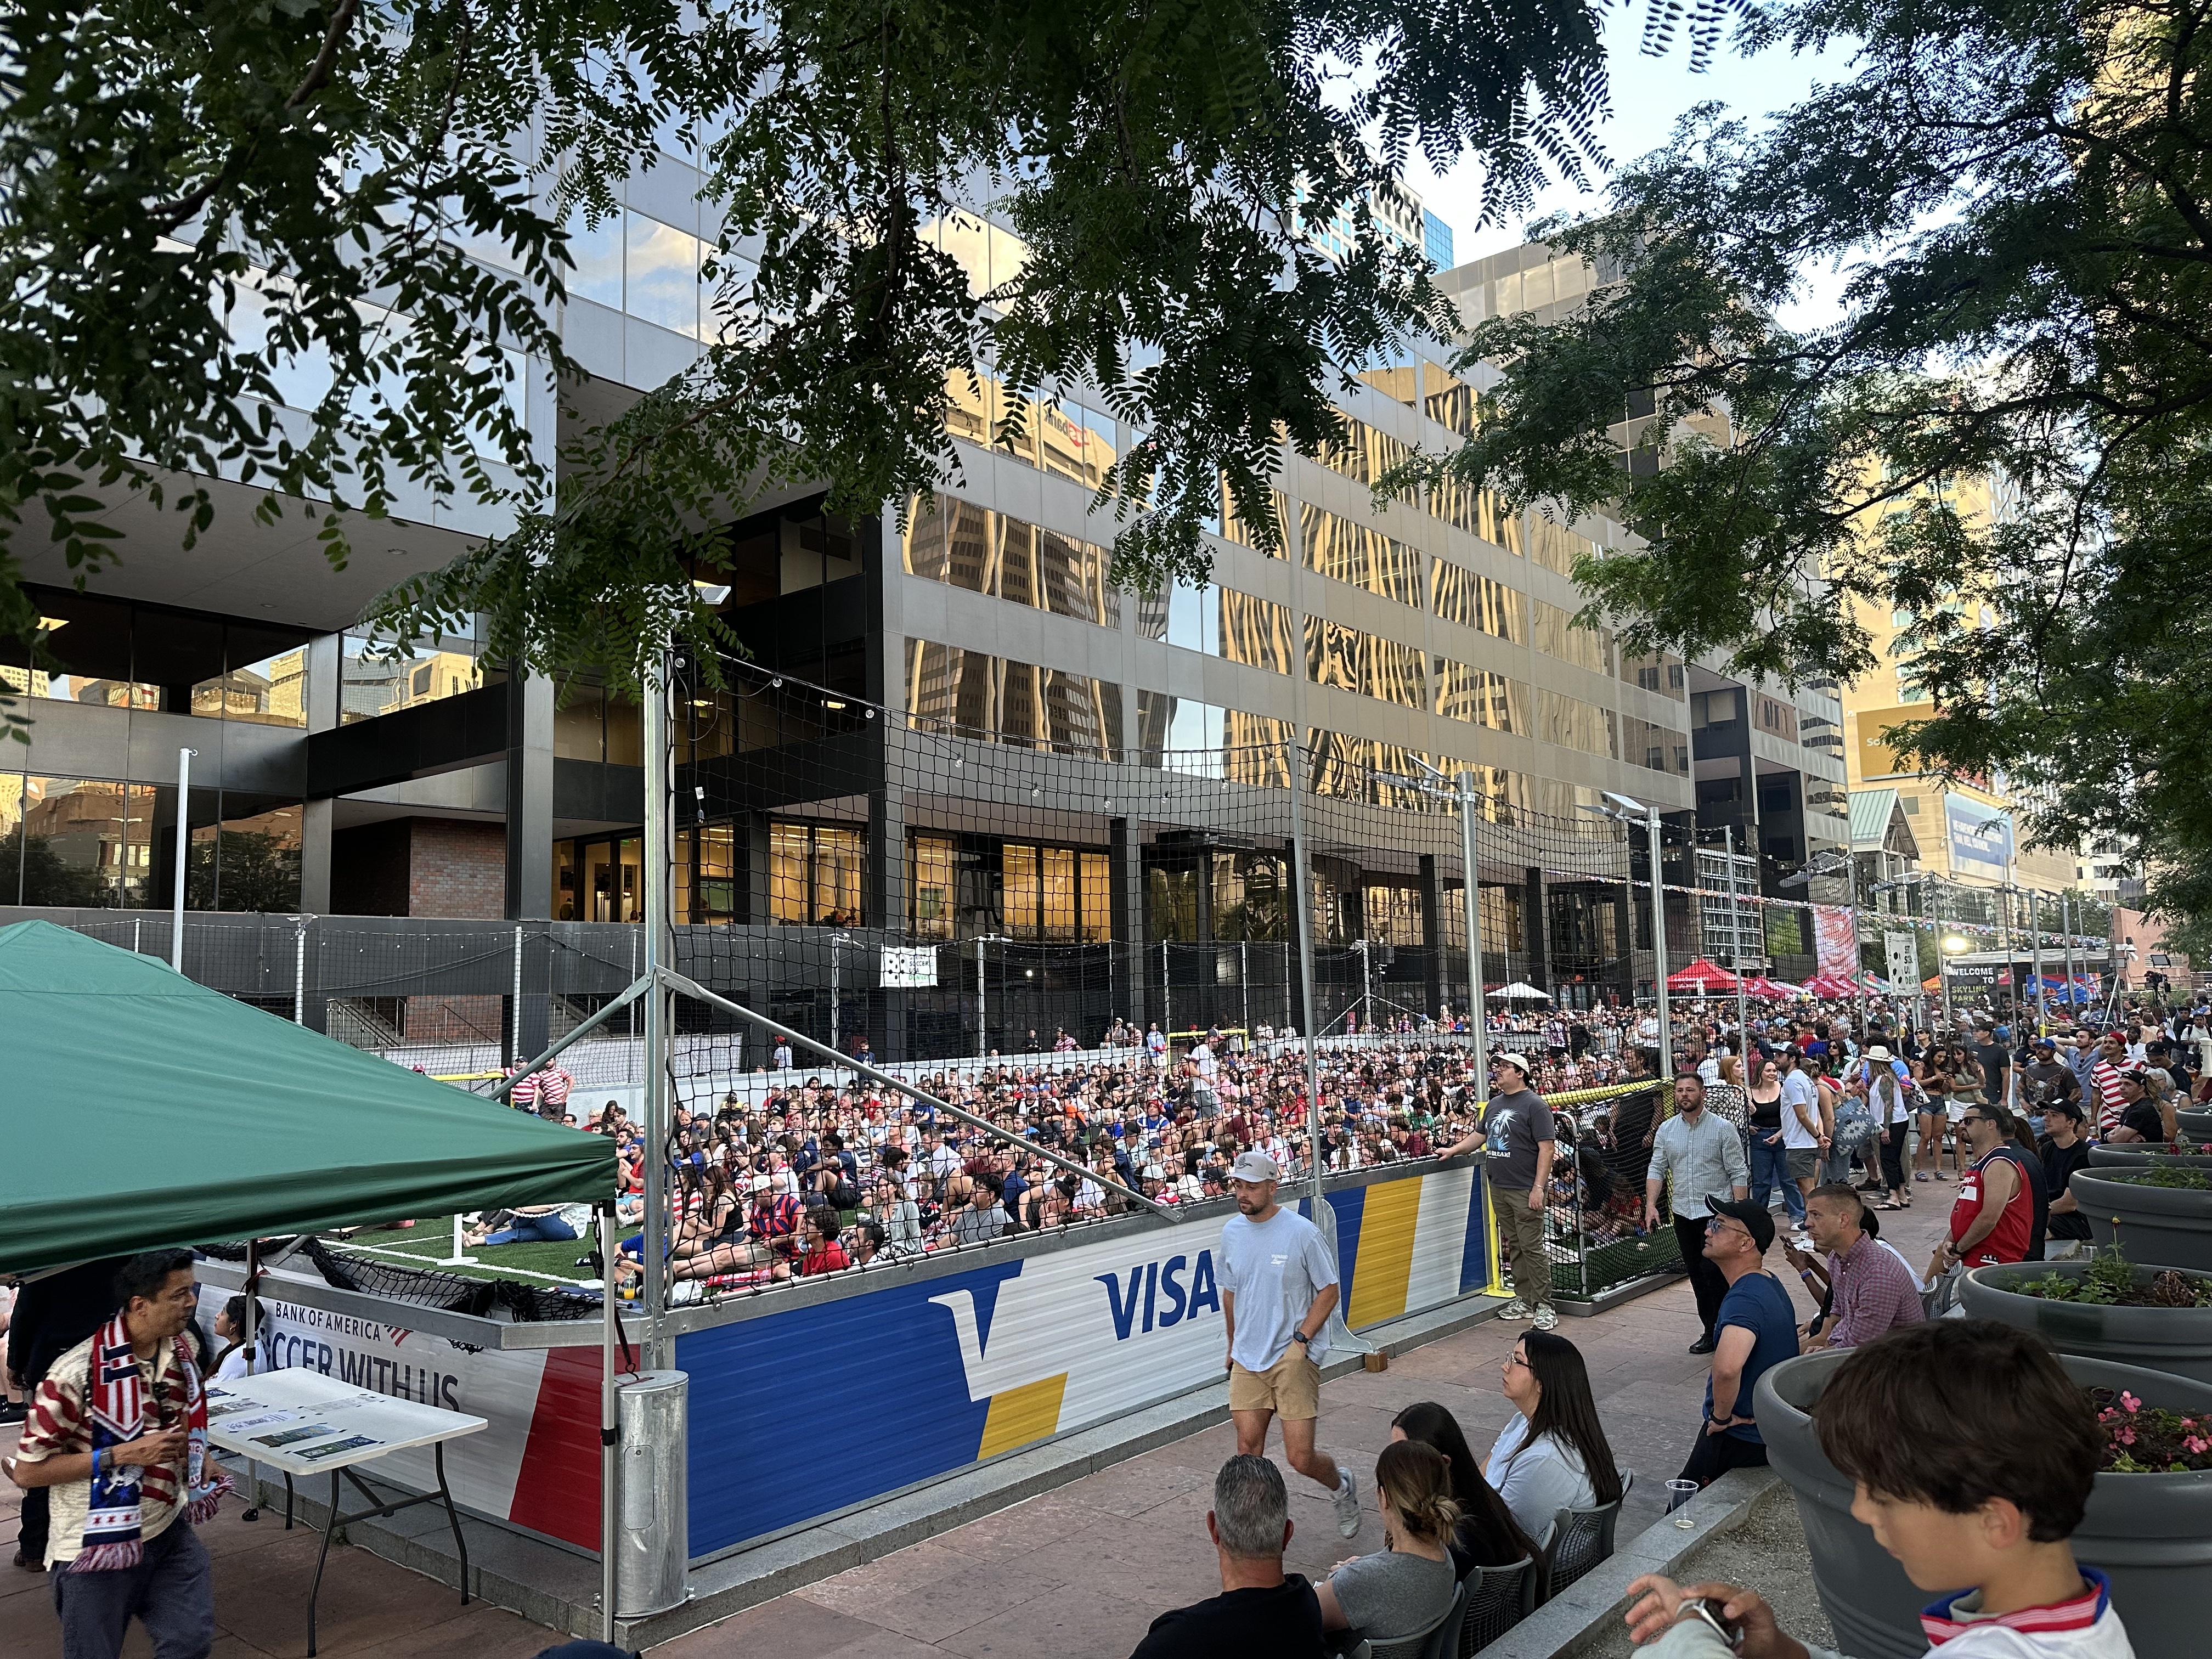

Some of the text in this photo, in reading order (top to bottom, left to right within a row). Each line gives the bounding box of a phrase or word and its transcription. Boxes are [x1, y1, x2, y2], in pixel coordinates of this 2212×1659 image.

[1951, 967, 1994, 976] WELCOME
[1951, 985, 1987, 994] SKYLINE
[1093, 1249, 1220, 1341] VISA
[276, 1302, 381, 1342] BANK OF AMERICA
[266, 1331, 460, 1413] CCER WITH US
